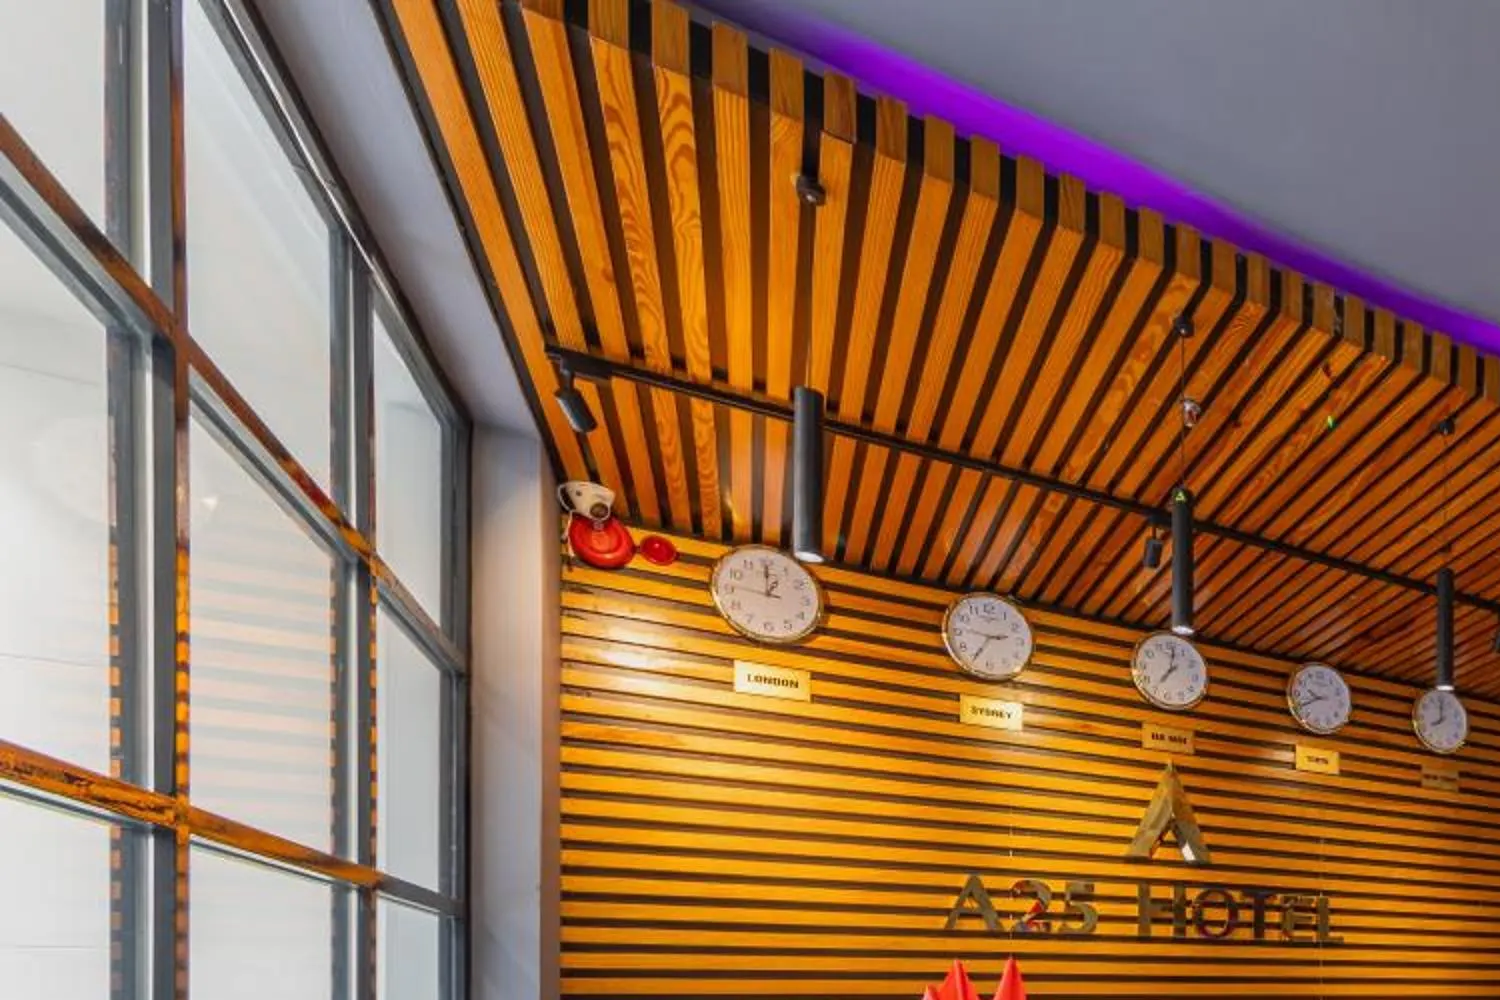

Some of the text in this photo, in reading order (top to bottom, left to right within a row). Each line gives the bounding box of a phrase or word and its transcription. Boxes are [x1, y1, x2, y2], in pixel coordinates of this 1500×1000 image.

[746, 673, 800, 689] LONDON
[944, 873, 1345, 944] A25 HOTEL
